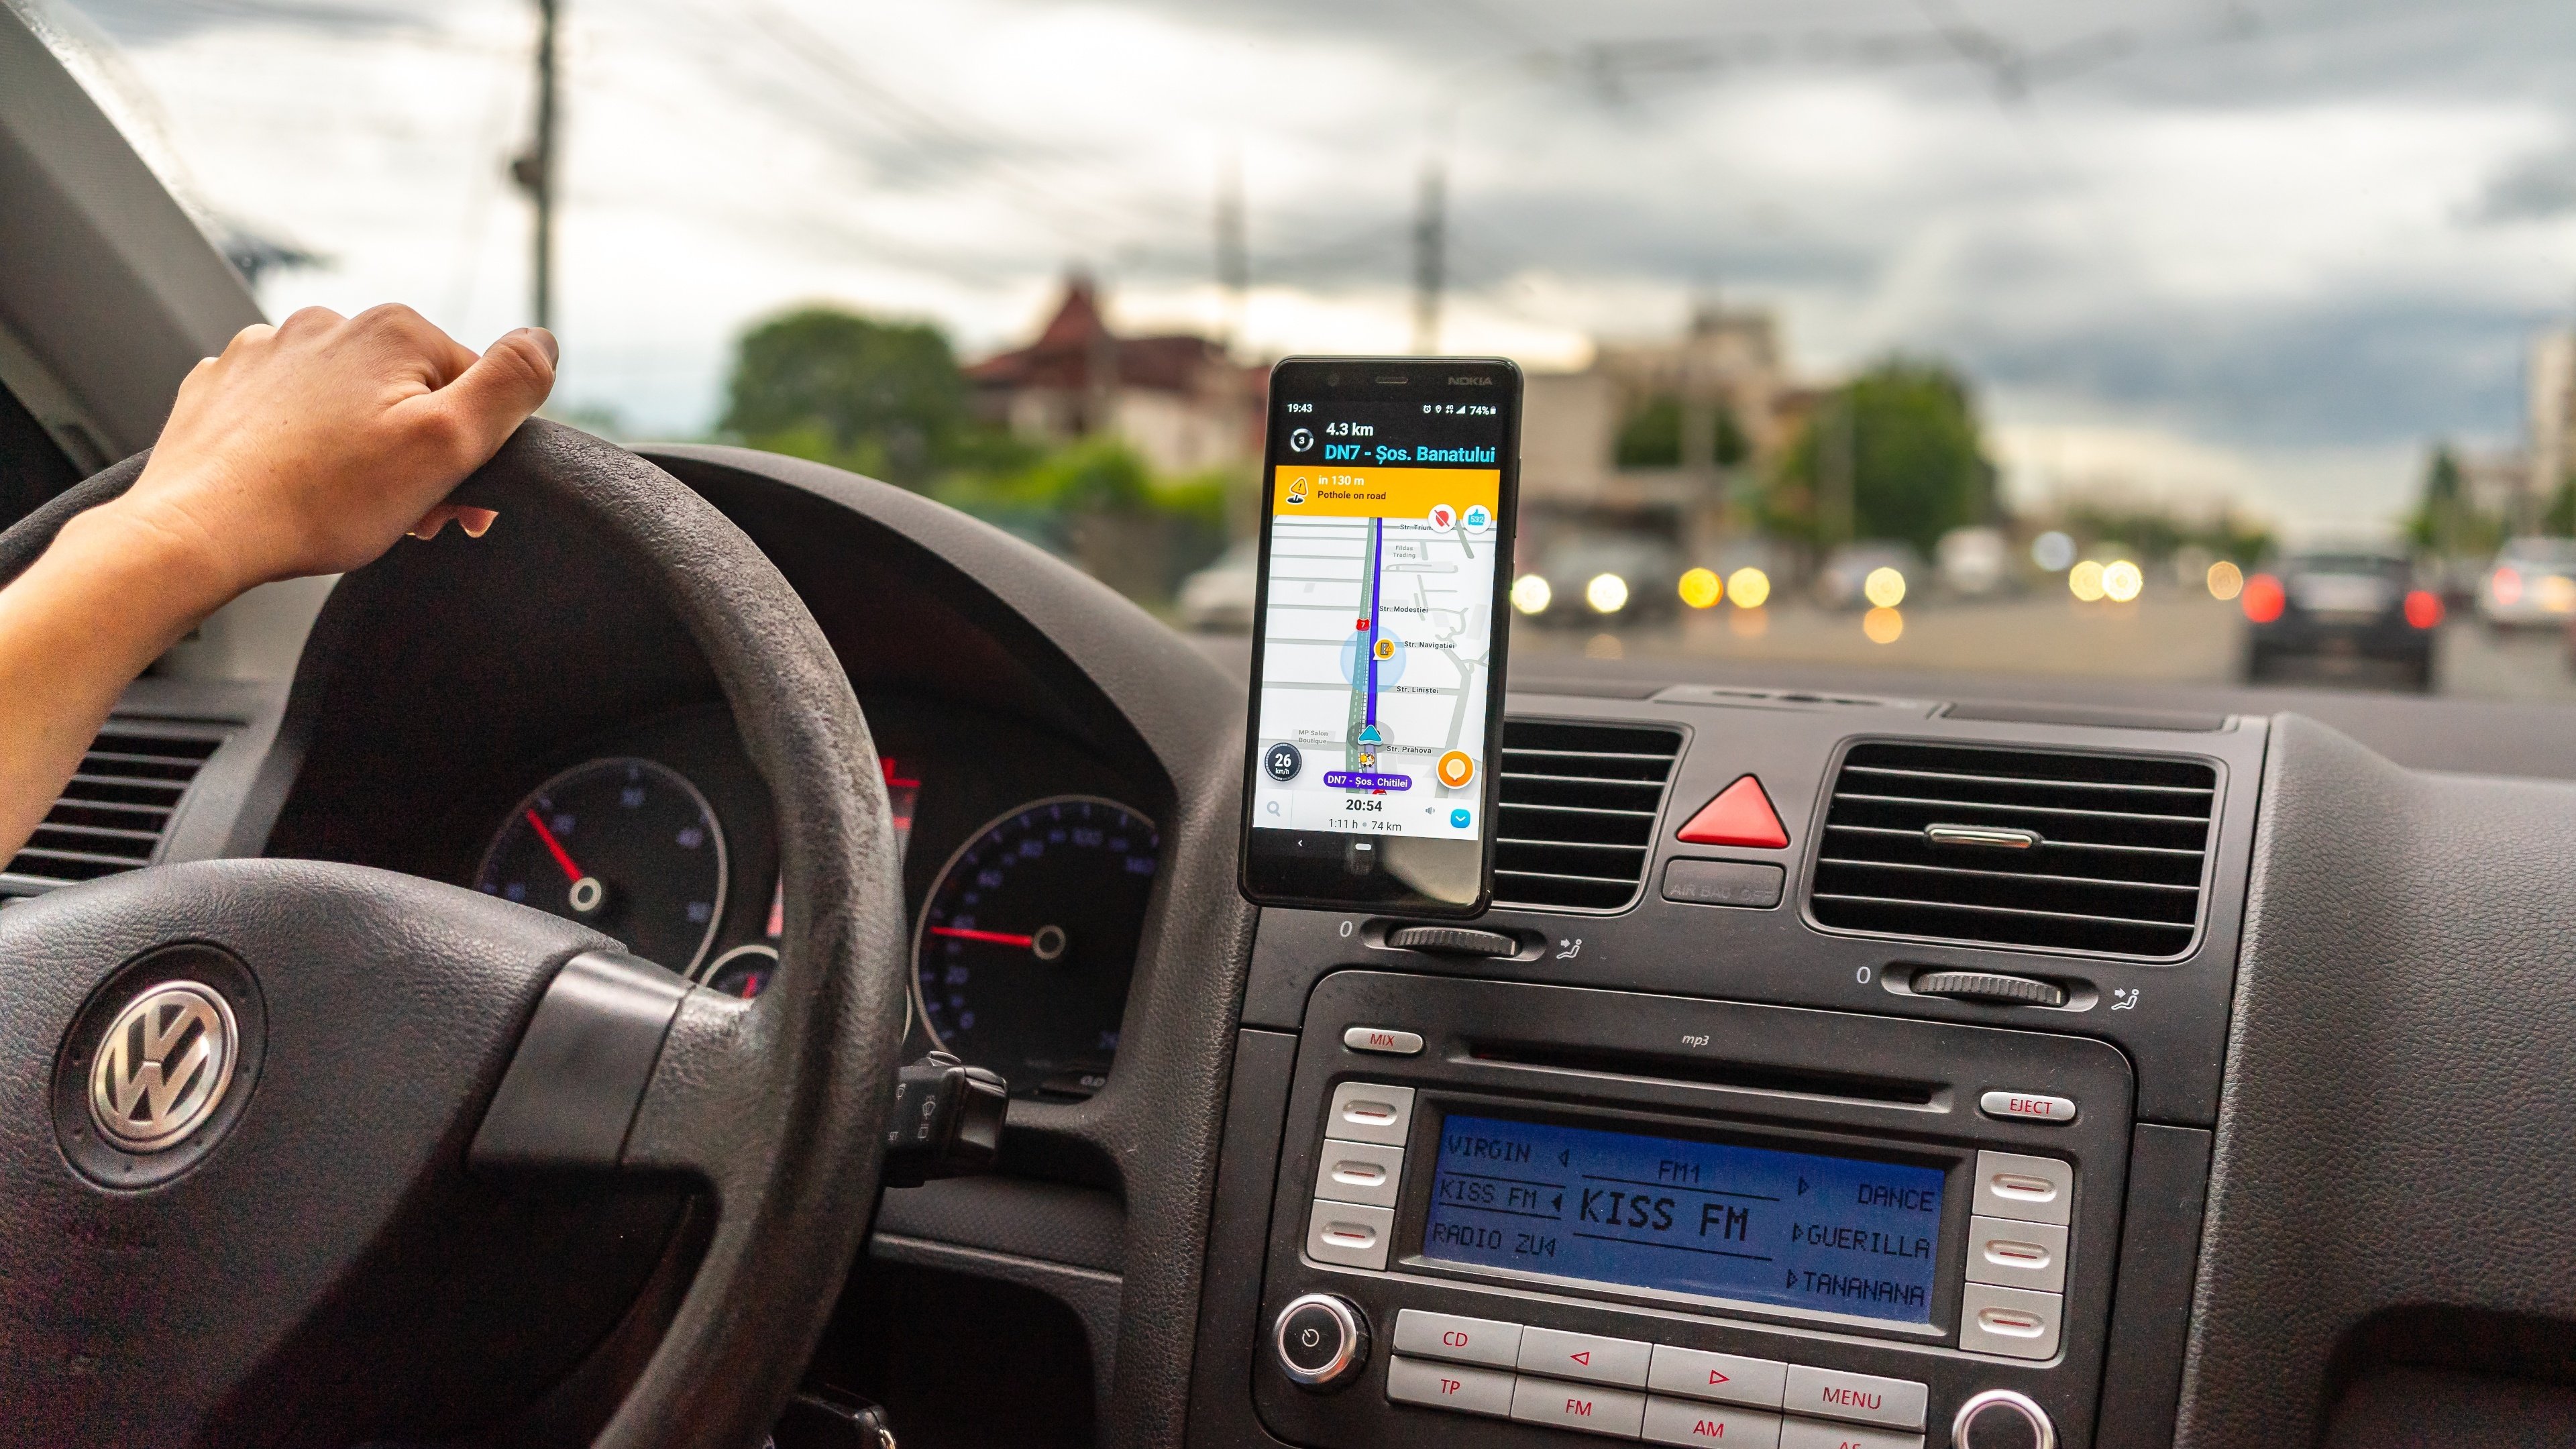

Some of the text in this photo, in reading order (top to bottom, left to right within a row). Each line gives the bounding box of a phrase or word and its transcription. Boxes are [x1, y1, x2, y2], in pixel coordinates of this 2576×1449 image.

[1448, 376, 1493, 386] NOKIA
[1287, 403, 1313, 413] 19:43
[1469, 405, 1489, 415] 74%
[1326, 422, 1374, 437] 4.3 km
[1298, 436, 1305, 445] 3
[1324, 444, 1361, 461] DN7
[1416, 445, 1496, 464] Banatului
[1318, 474, 1364, 486] in 130 m
[1317, 490, 1351, 500] Pothole
[1366, 492, 1387, 500] road
[1393, 551, 1416, 559] Trading
[1394, 606, 1429, 614] Modestiei
[1299, 737, 1327, 745] Boutique
[1402, 746, 1432, 754] Prahova
[1275, 753, 1292, 768] 26
[1275, 767, 1290, 775] km/h
[1328, 775, 1346, 785] DN7
[1377, 777, 1409, 788] Chitilei
[1346, 799, 1383, 812] 20:54
[1328, 818, 1402, 832] 1:11 h 74 km
[1369, 1032, 1395, 1047] MIX
[1681, 1034, 1710, 1048] mp3
[2009, 1098, 2054, 1116] EJECT
[1448, 1134, 1531, 1163] VIRGIN
[1658, 1160, 1701, 1184] FM1
[1440, 1179, 1538, 1210] KISS FM
[1858, 1183, 1935, 1212] DANCE
[1579, 1188, 1749, 1242] KISS FM
[1432, 1222, 1502, 1250] RADIO
[1807, 1224, 1931, 1260] GUERILLA
[1803, 1271, 1925, 1307] TANANANA
[1442, 1330, 1469, 1348] CD
[1440, 1379, 1461, 1396] TP
[1822, 1387, 1882, 1410] MENU
[1564, 1399, 1593, 1417] FM
[1693, 1419, 1725, 1439] AM
